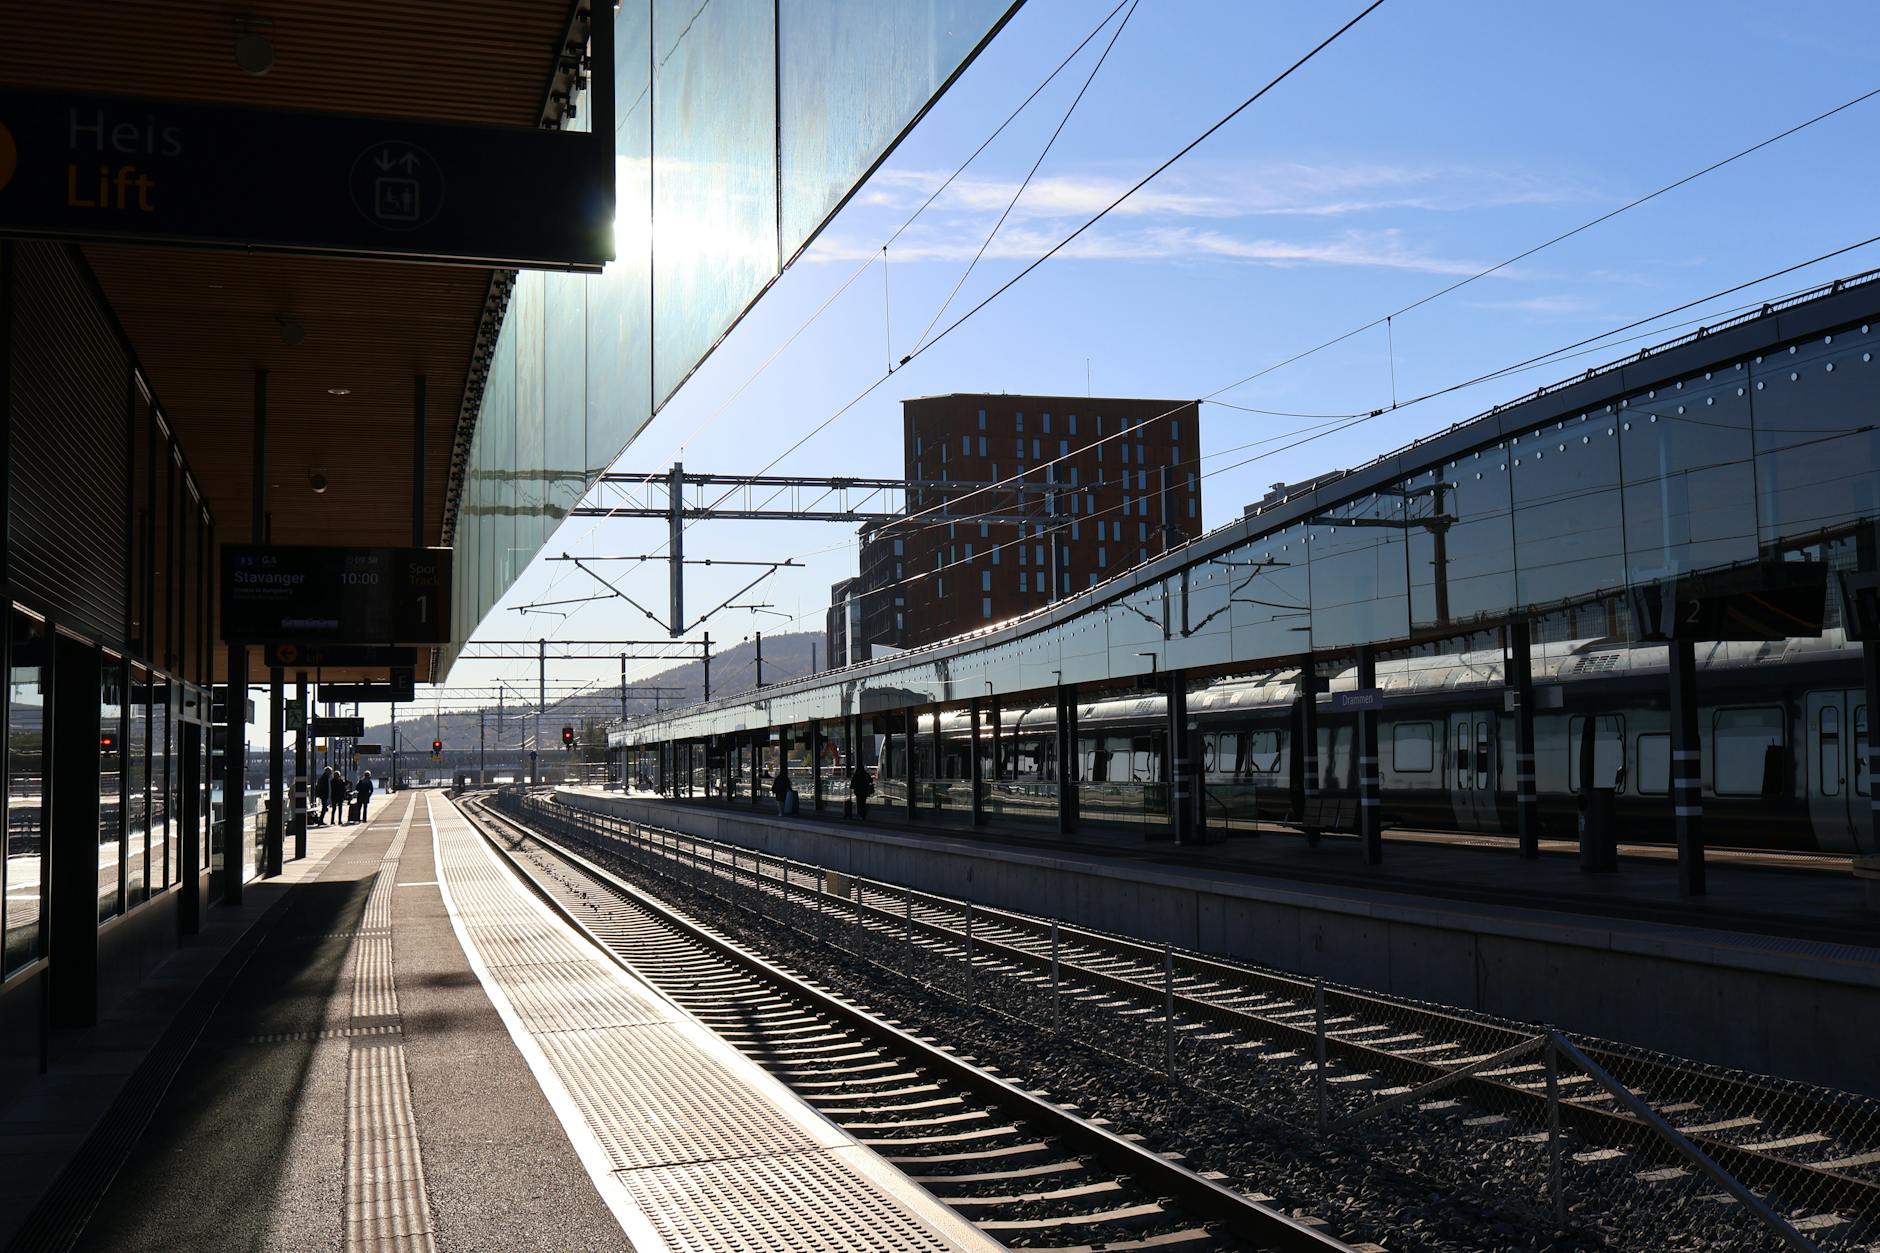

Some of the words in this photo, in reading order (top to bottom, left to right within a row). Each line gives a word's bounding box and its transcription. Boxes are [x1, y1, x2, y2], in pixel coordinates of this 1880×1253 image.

[68, 106, 183, 158] Heis
[67, 162, 159, 213] Lift
[408, 563, 437, 577] Spor
[234, 571, 305, 586] Stavanger
[340, 572, 379, 585] 10:00
[408, 574, 440, 585] Track
[415, 594, 428, 624] 1
[1684, 599, 1702, 624] 2
[1342, 693, 1374, 707] Drammen
